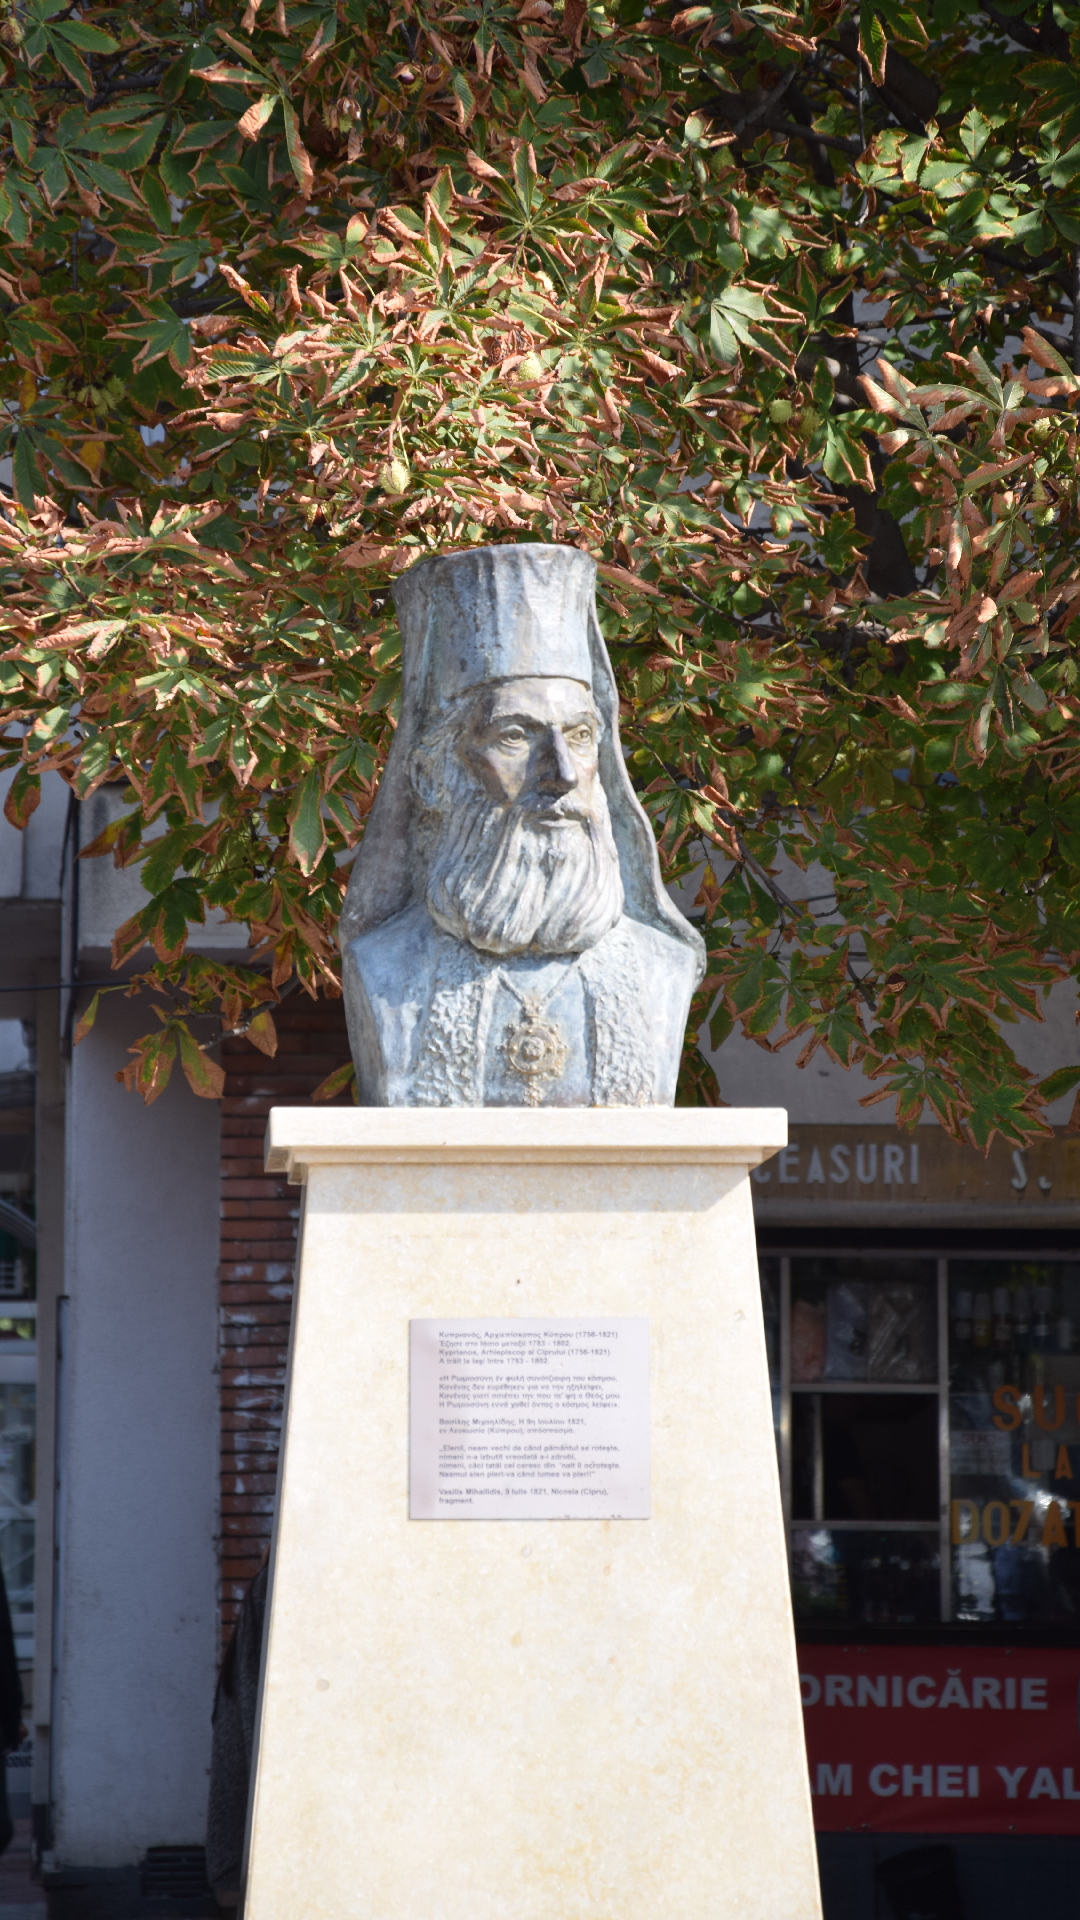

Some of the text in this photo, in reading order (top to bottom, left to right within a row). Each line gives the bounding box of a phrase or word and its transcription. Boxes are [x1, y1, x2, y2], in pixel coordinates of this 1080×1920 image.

[543, 1331, 573, 1339] Κύπρου
[575, 1331, 618, 1339] (1756-1821)
[992, 1384, 1080, 1432] SU
[810, 1764, 852, 1796] M
[868, 1763, 979, 1798] CHEI
